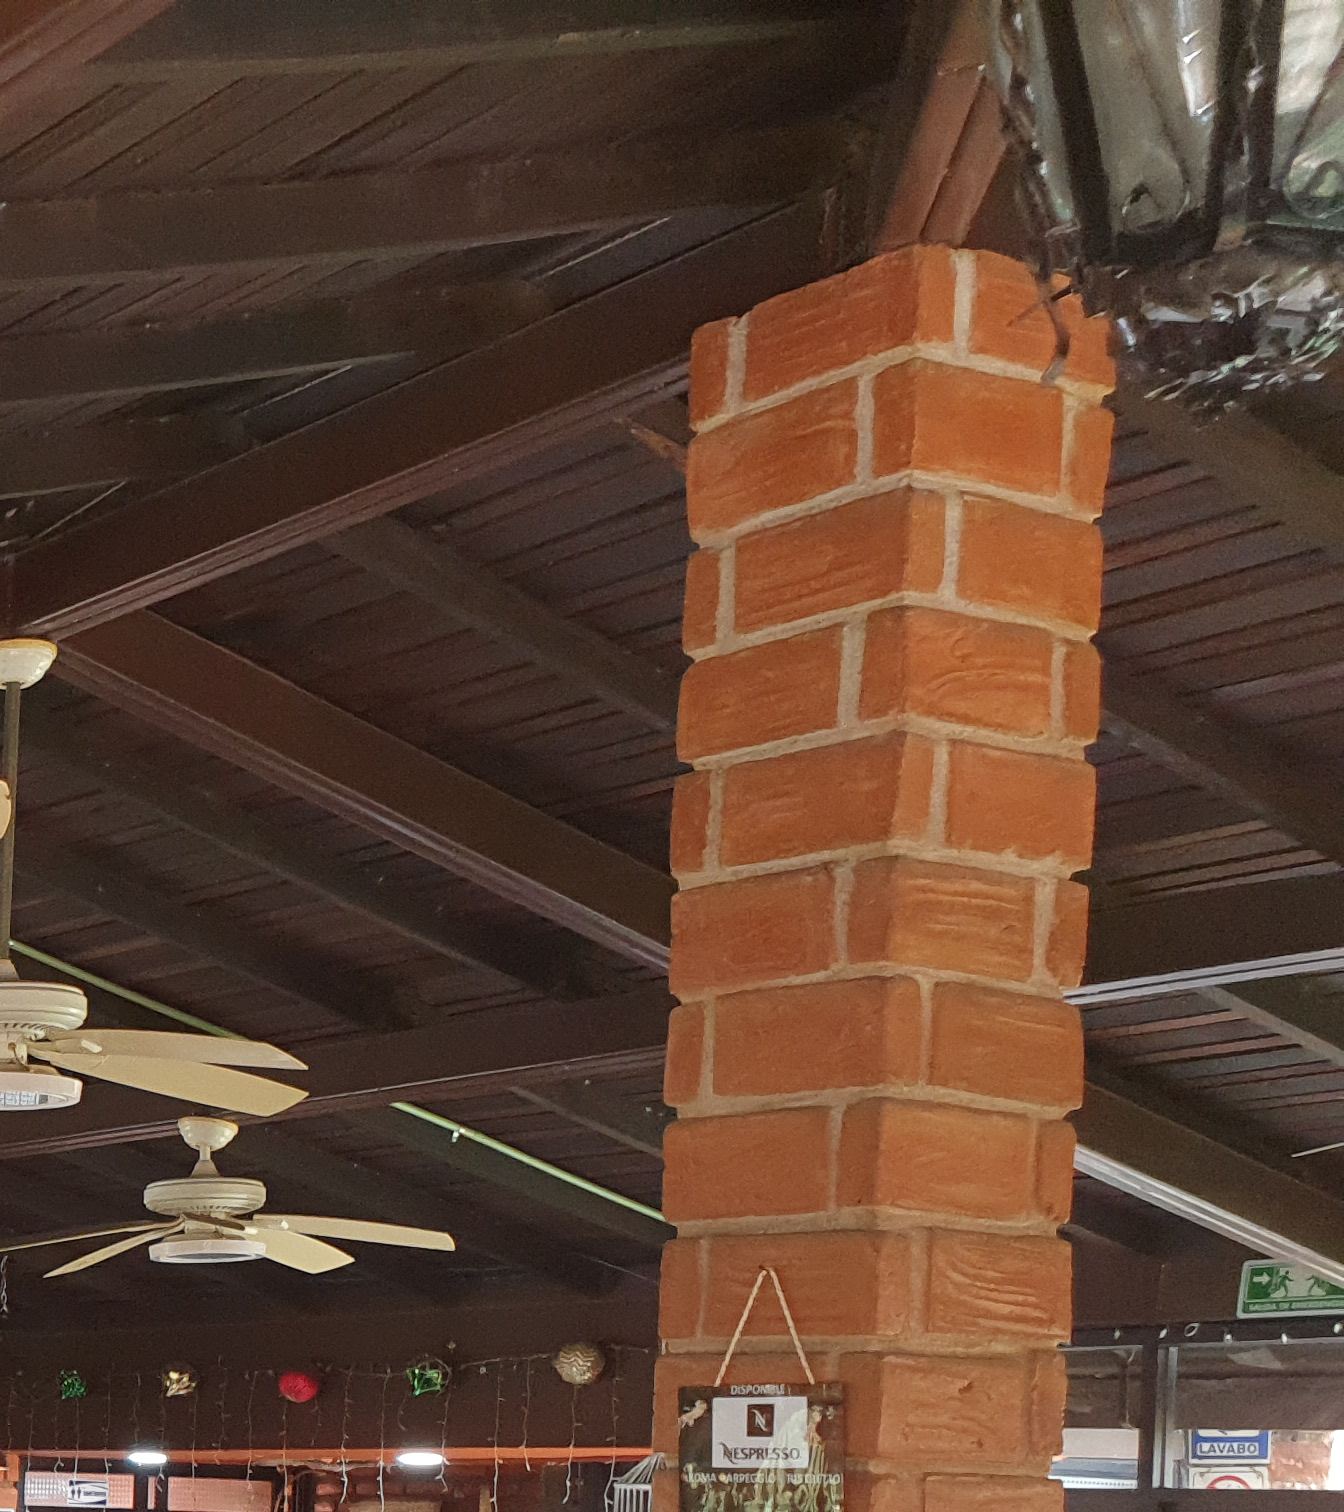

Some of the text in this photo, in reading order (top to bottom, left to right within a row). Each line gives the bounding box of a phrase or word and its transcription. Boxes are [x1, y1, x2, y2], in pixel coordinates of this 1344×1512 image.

[730, 1384, 785, 1396] DISPONIBLE
[719, 1441, 801, 1464] NESPRESSO
[1198, 1442, 1258, 1455] LAVABO
[726, 1472, 775, 1484] ARPEGGIO
